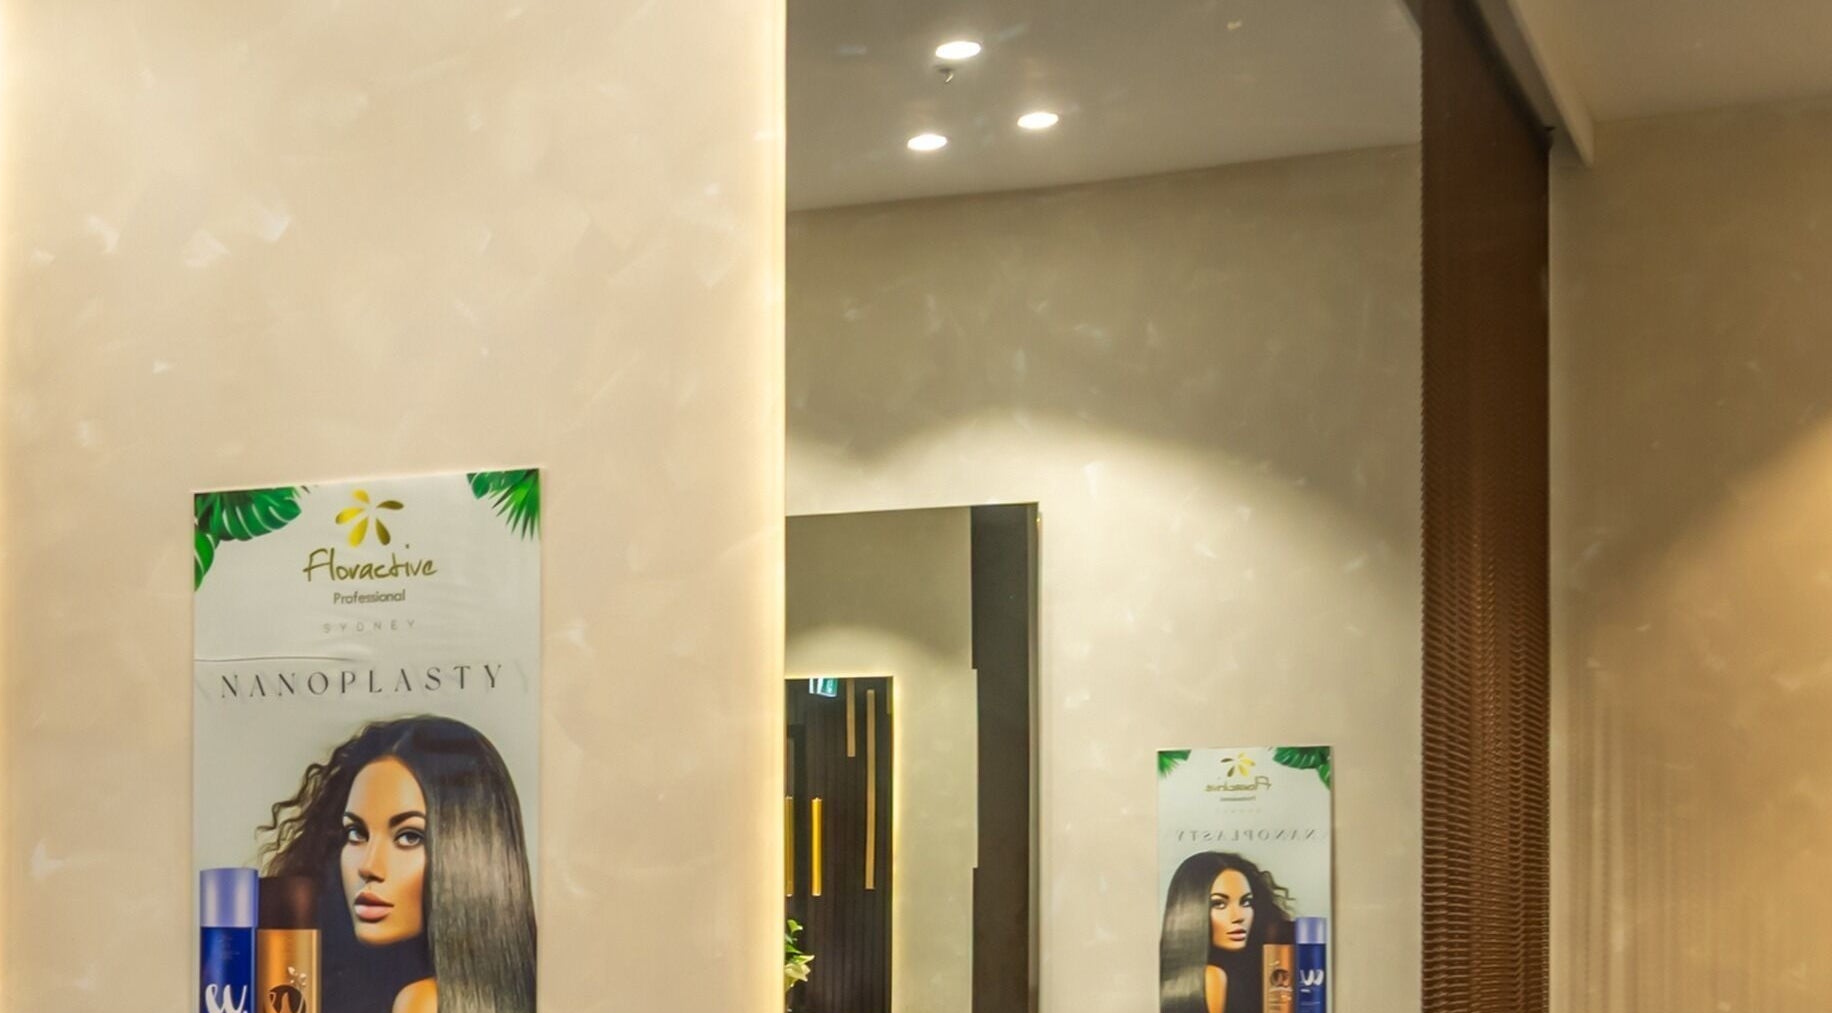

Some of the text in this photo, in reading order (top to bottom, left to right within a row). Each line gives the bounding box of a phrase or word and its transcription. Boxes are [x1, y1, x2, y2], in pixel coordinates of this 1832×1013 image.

[302, 543, 438, 583] Floractive
[333, 589, 407, 605] Professional
[323, 619, 417, 633] SYDNEY
[220, 664, 504, 699] NANOPLASTY
